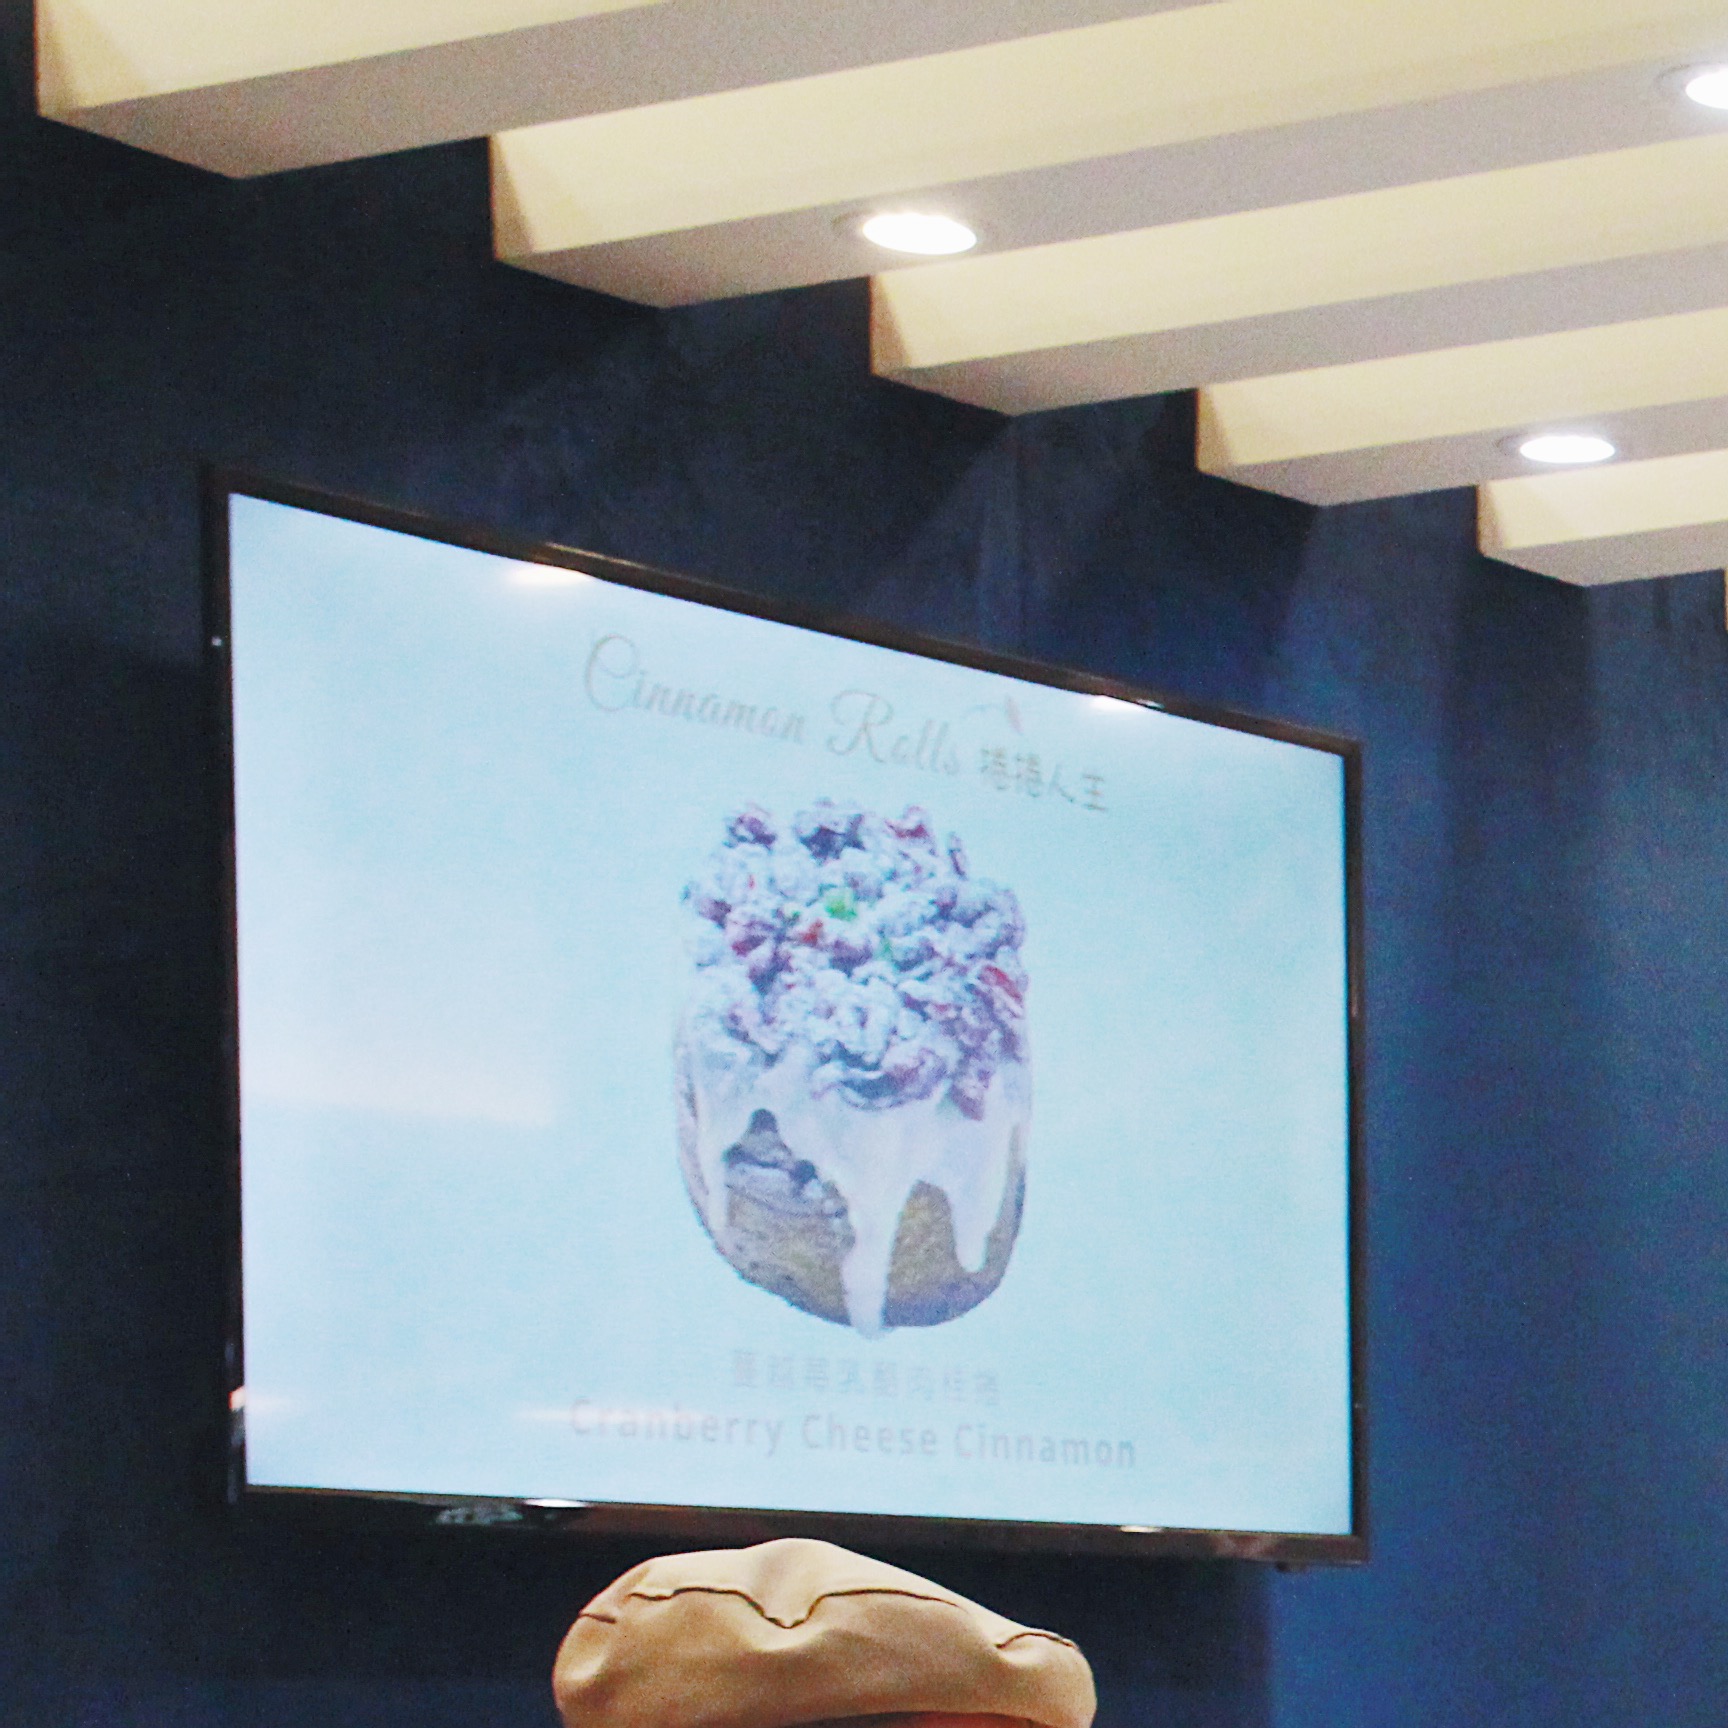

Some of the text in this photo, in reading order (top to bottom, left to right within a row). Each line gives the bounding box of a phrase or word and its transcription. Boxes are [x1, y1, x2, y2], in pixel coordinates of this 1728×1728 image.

[583, 633, 962, 777] Cinnamon Rolls
[568, 1397, 1137, 1469] Cranberry Cheese Cinnamon
